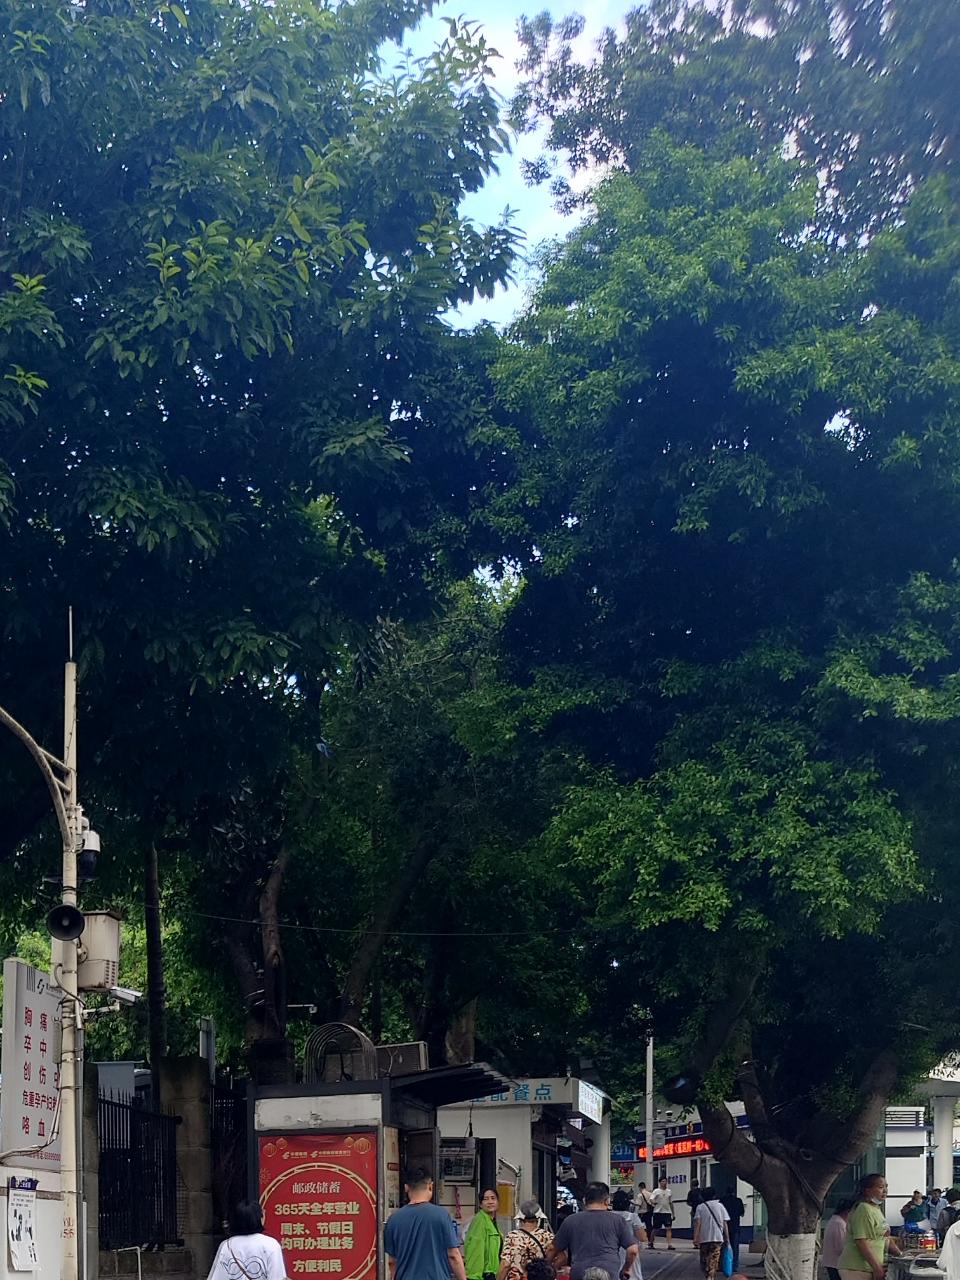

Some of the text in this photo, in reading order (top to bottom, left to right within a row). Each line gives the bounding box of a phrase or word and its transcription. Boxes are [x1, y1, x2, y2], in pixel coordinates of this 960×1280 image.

[292, 1181, 341, 1194] 邮政储蓄
[274, 1202, 360, 1215] 365天全年营业
[280, 1221, 353, 1236] 周末、节假日
[281, 1236, 354, 1250] 均可办理业务
[292, 1259, 342, 1273] 方便利民
